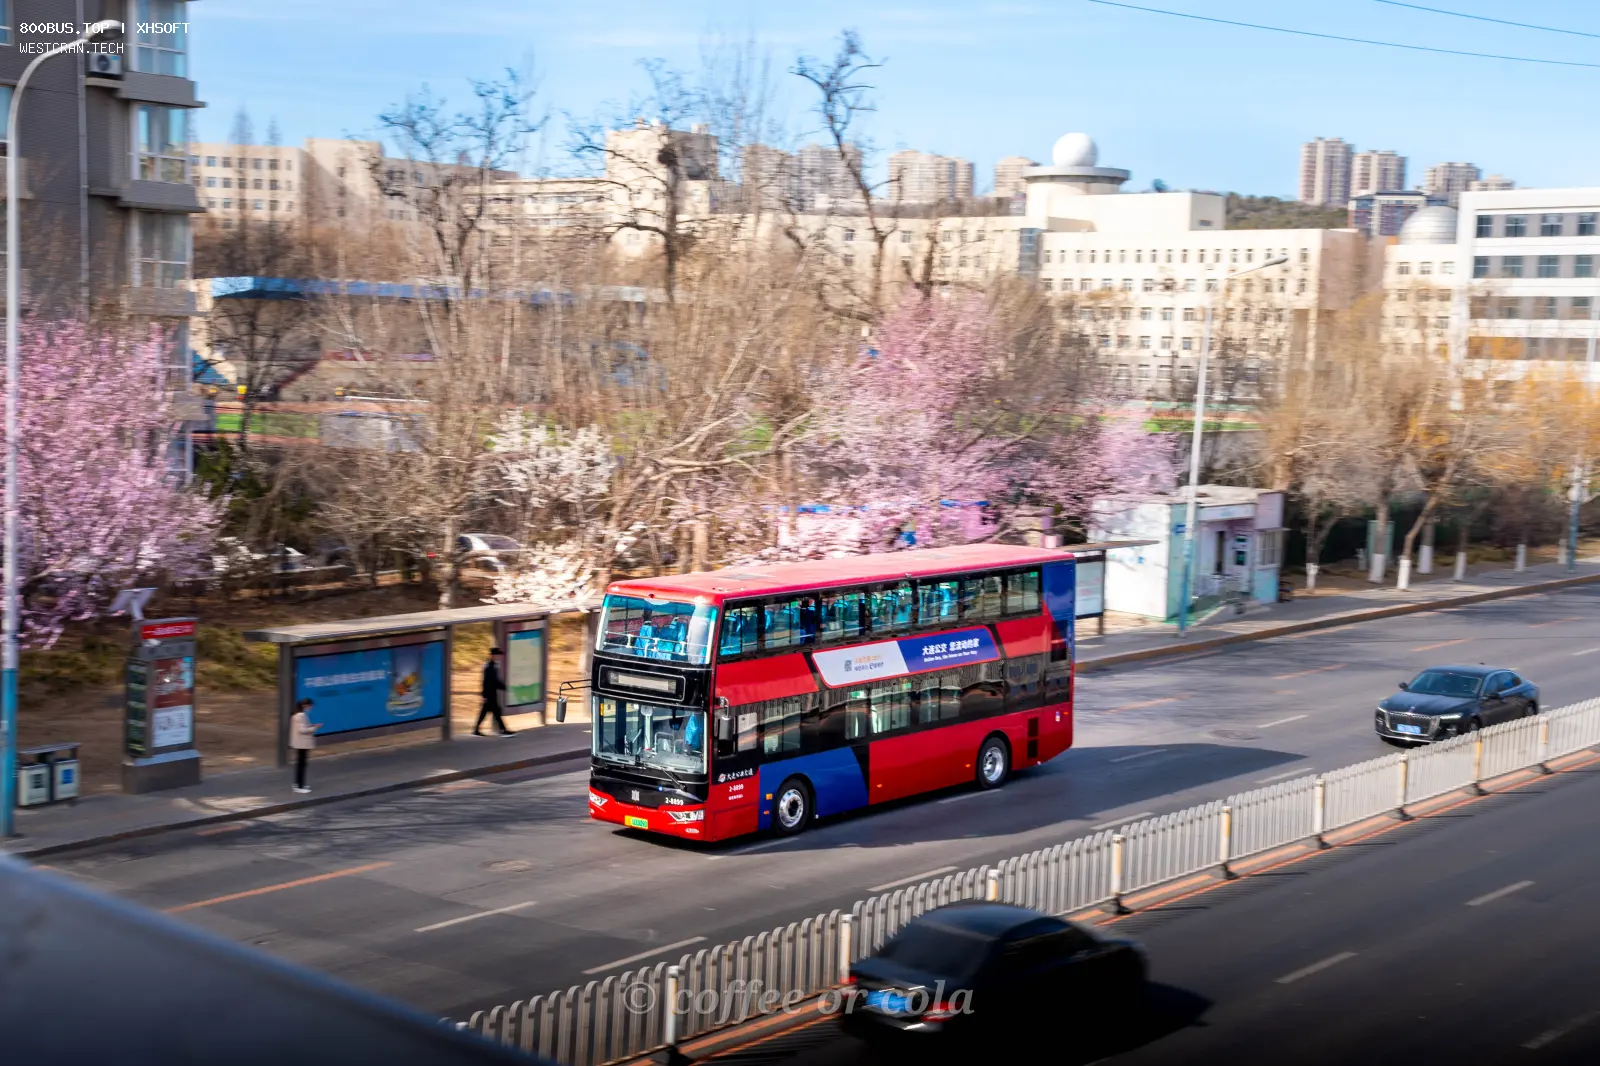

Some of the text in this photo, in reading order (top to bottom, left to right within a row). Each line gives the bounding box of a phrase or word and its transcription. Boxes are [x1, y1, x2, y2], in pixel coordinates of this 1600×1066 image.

[922, 643, 947, 656] 大连公交
[665, 797, 684, 806] 2-8899
